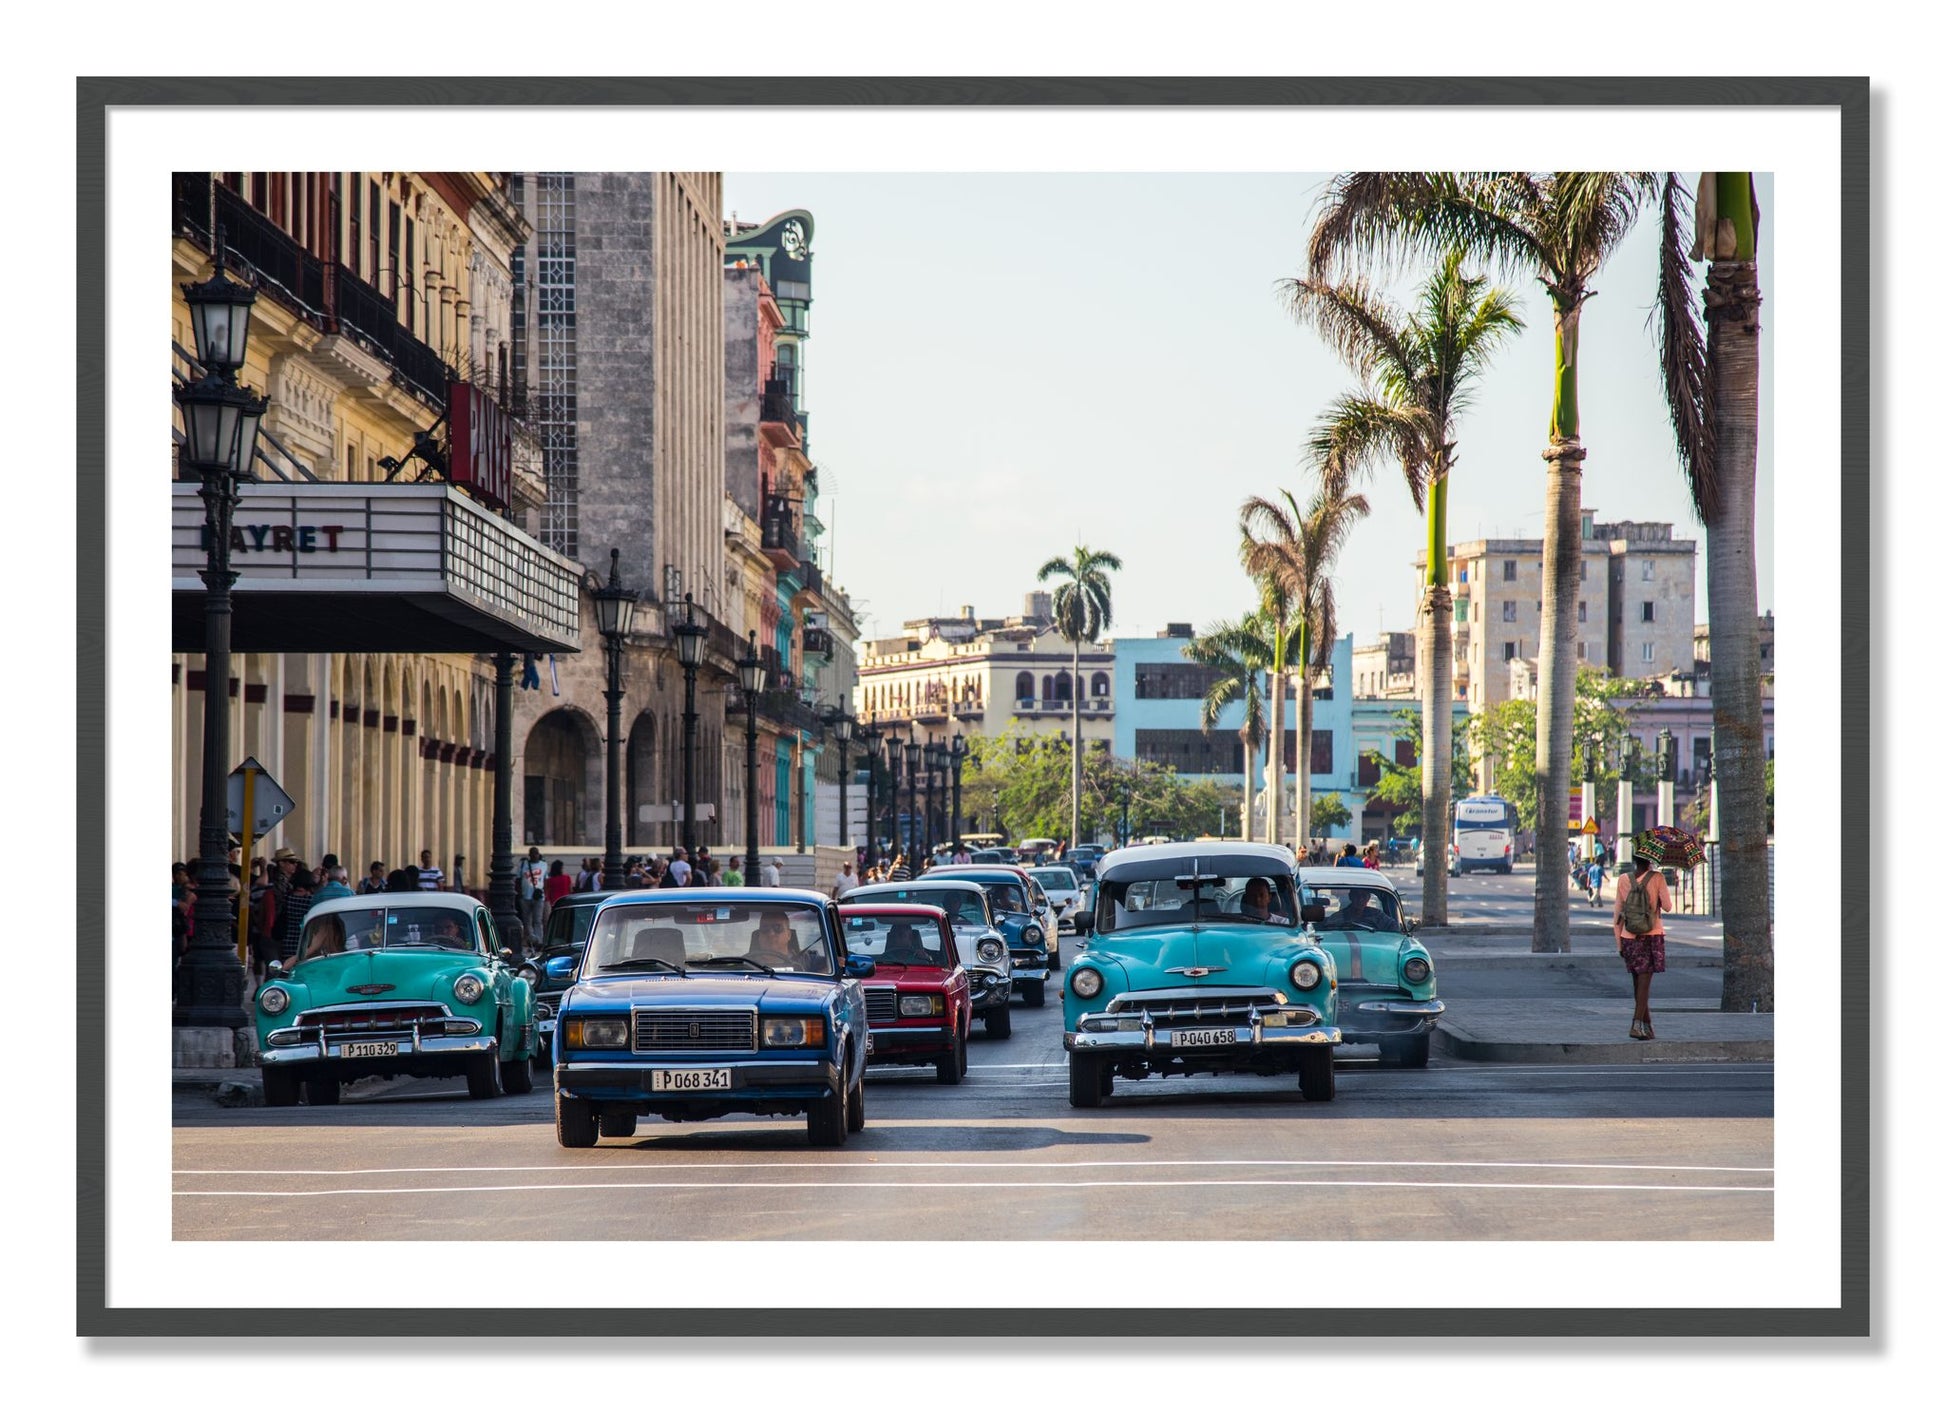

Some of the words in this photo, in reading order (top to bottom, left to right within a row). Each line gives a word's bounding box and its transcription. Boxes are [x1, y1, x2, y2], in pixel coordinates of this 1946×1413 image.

[1180, 1032, 1187, 1046] P
[1190, 1031, 1210, 1045] 040
[1213, 1030, 1234, 1044] 658
[348, 1043, 355, 1056] P
[356, 1045, 375, 1057] 110
[377, 1043, 396, 1056] 329
[663, 1070, 671, 1089] P
[675, 1073, 700, 1088] 068
[703, 1071, 728, 1087] 341
